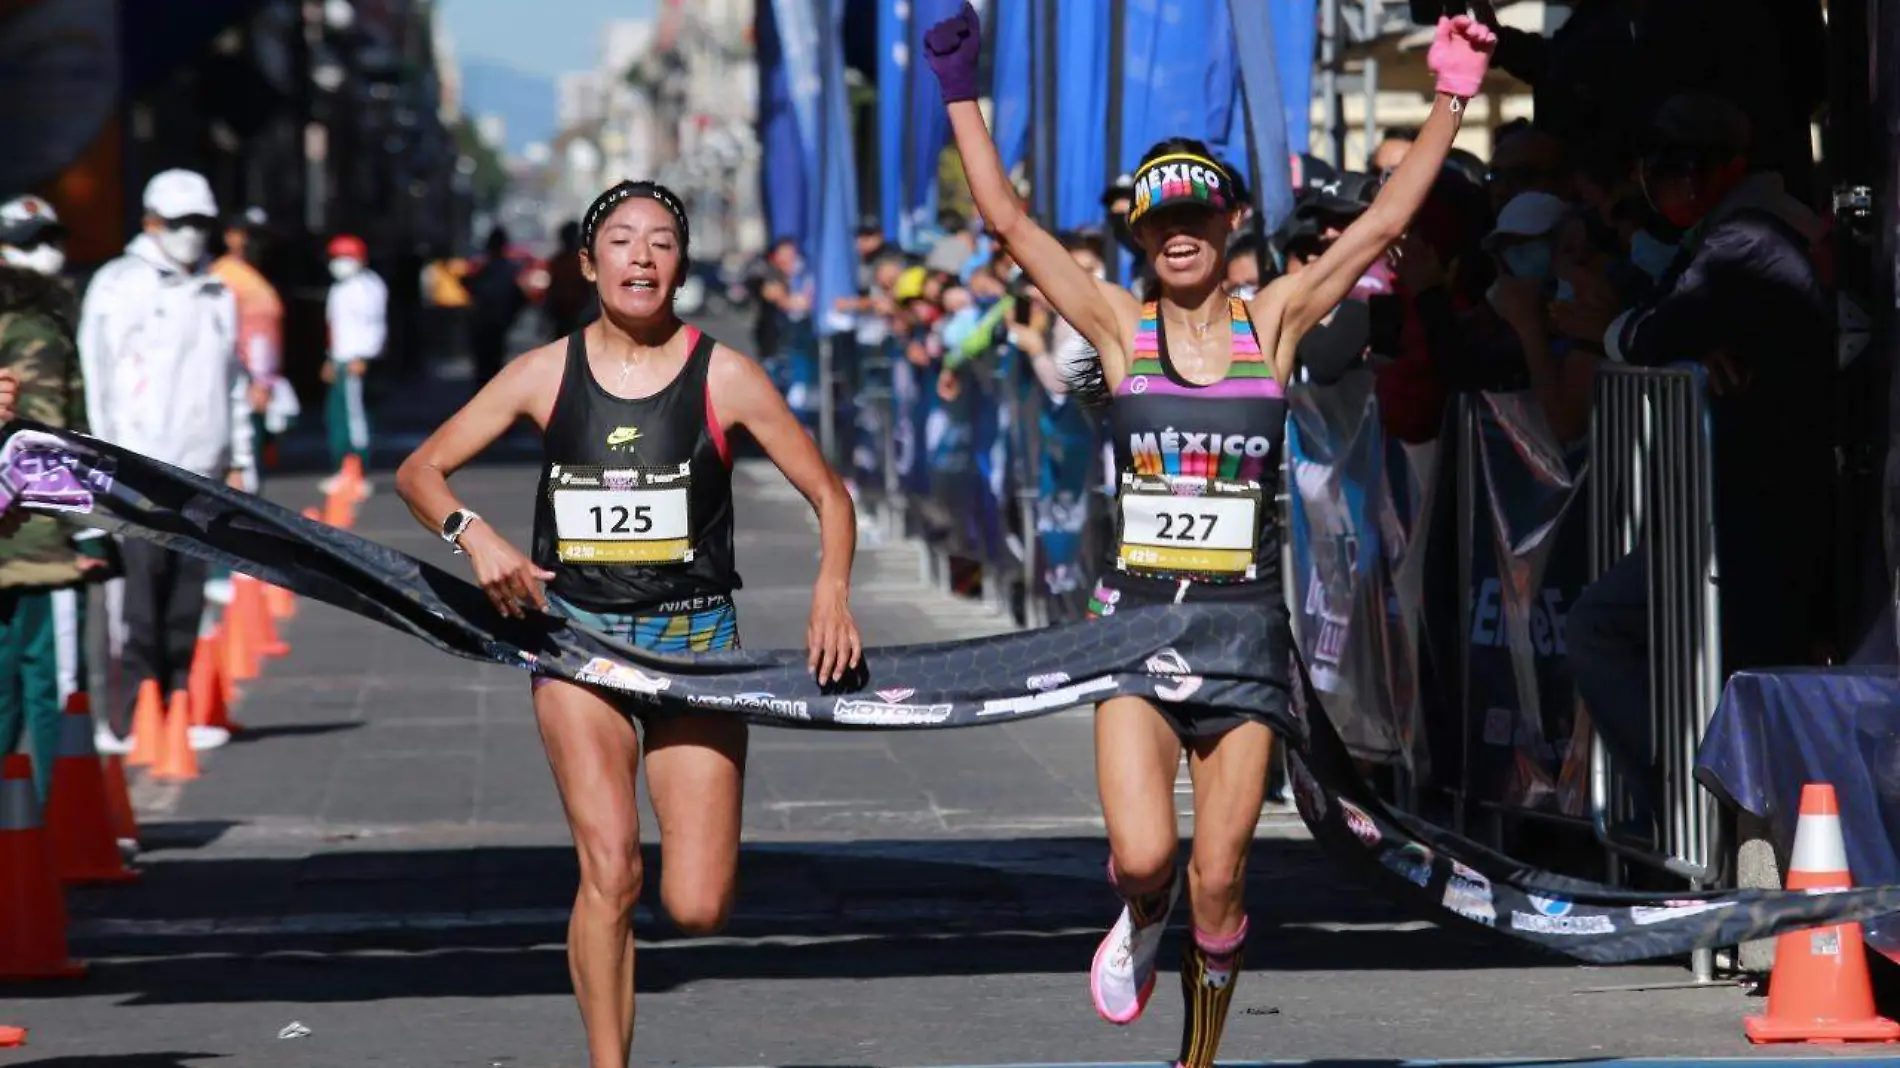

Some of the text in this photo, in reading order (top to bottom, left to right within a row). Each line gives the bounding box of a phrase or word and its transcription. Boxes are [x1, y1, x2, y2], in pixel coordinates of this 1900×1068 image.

[1130, 426, 1270, 458] MÉXICO
[589, 506, 653, 534] 125
[1155, 512, 1218, 541] 227
[658, 597, 705, 612] NIKE
